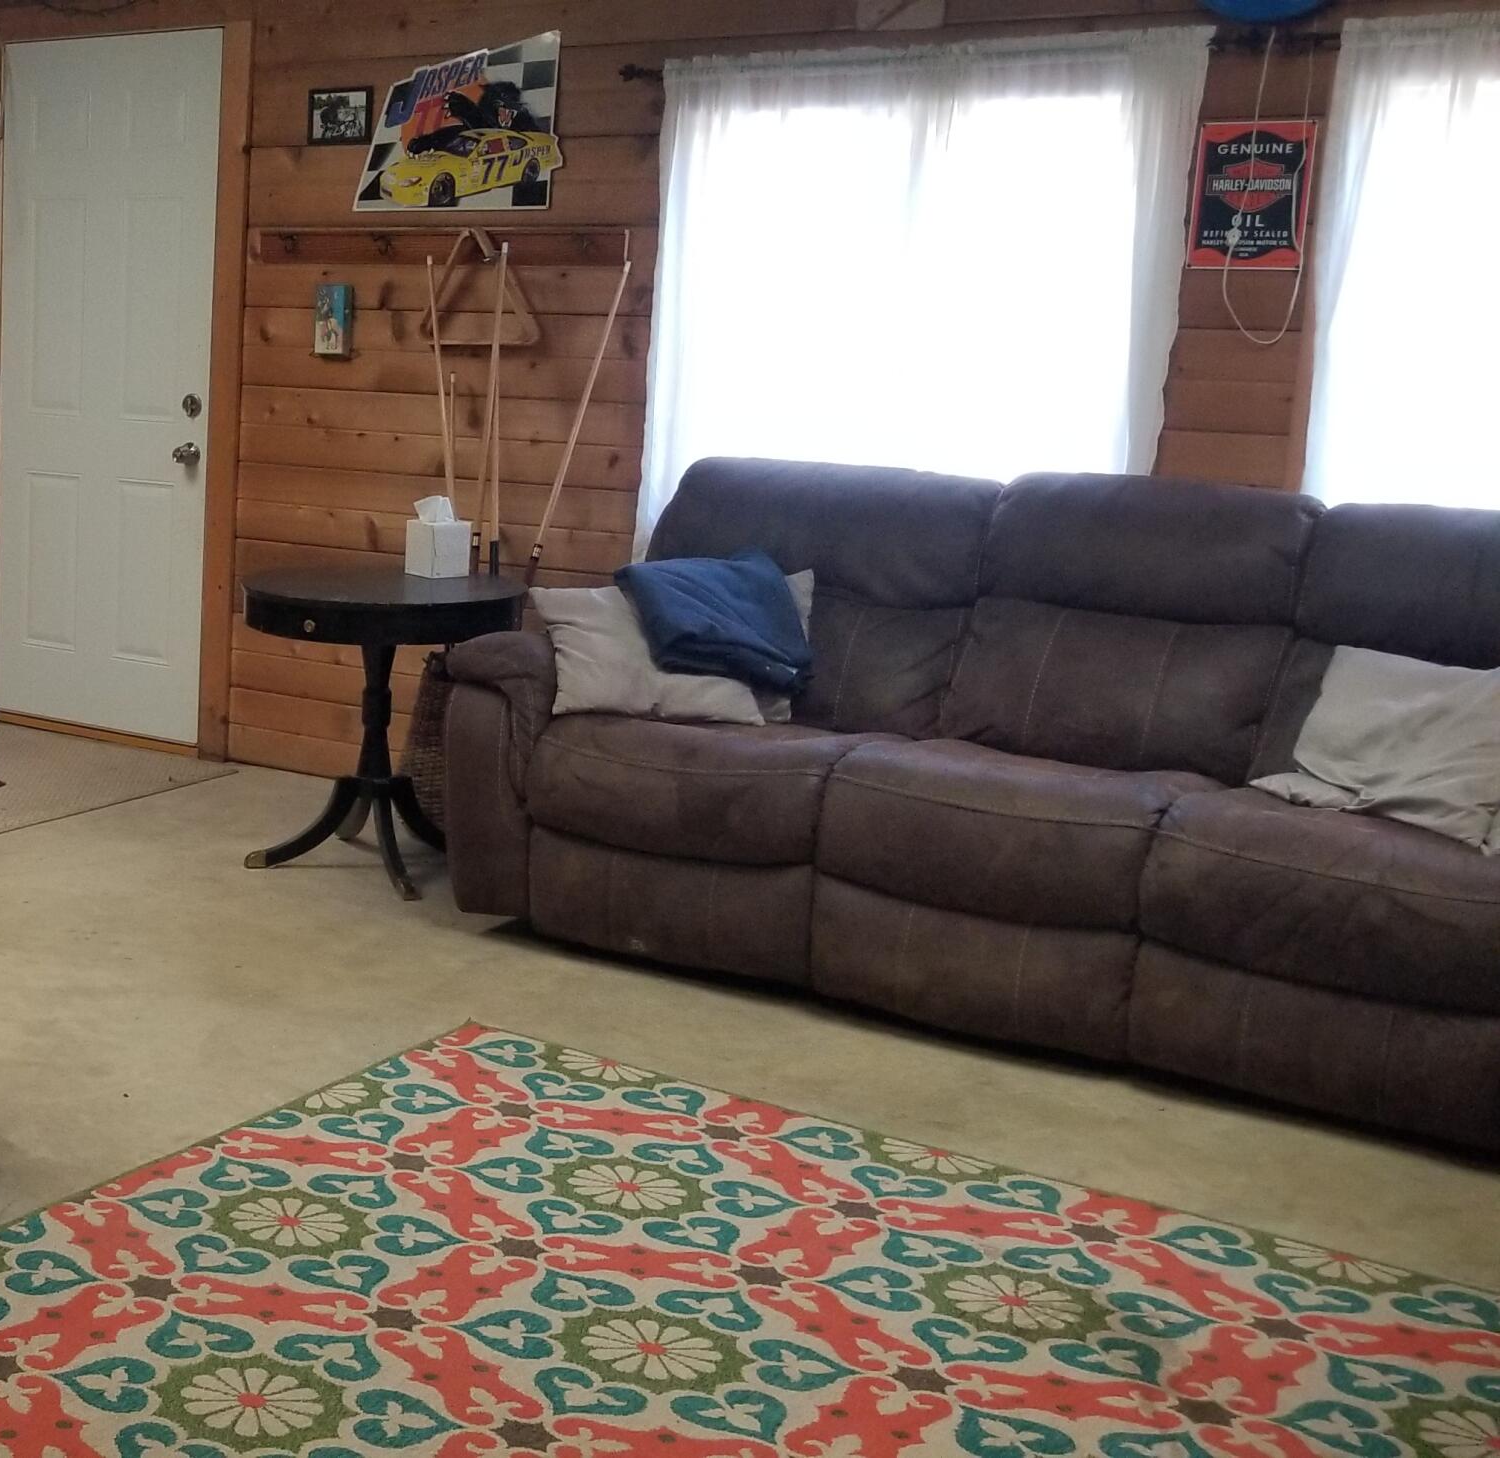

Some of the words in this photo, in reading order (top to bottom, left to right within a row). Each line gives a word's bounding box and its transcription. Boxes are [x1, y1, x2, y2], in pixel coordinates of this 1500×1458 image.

[384, 52, 486, 128] JASPER
[1217, 143, 1293, 154] GENUINE
[481, 155, 509, 185] 77
[1212, 178, 1292, 192] HARLEY-DAVIDSON
[1231, 214, 1265, 228] OIL
